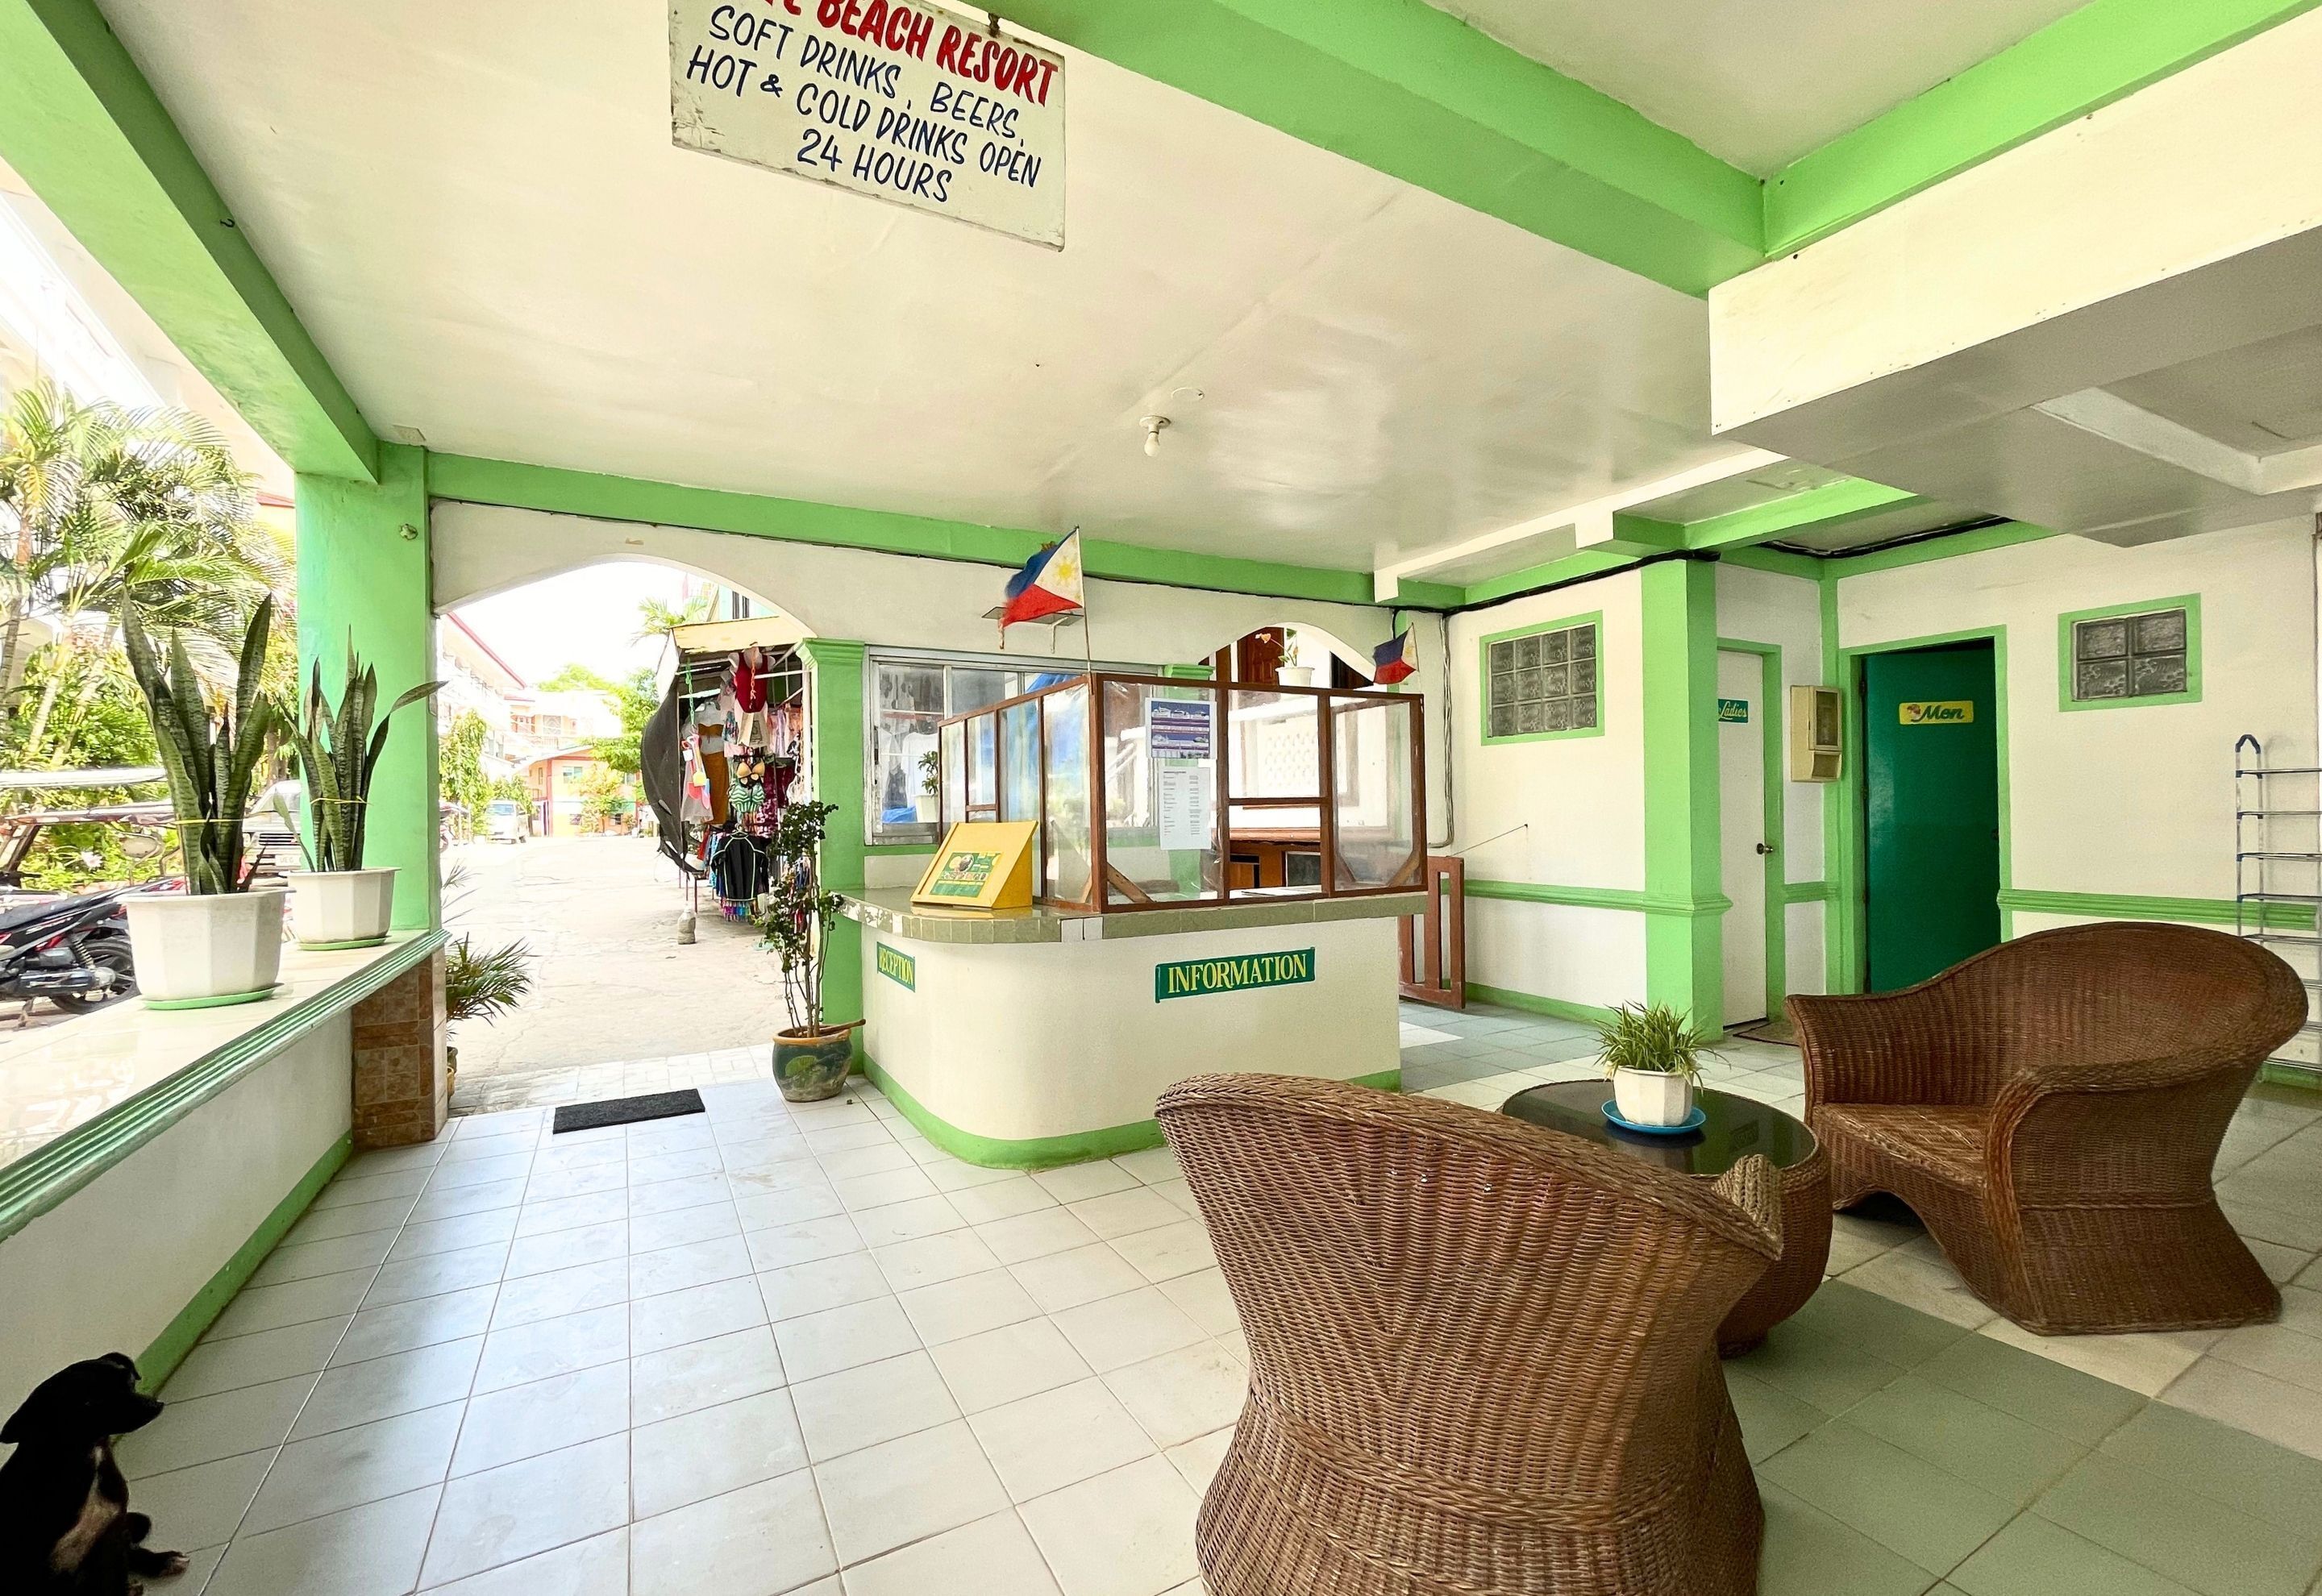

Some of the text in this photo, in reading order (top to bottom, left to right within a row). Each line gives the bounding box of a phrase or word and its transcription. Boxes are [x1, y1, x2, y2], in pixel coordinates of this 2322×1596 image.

[710, 6, 794, 60] SOFT
[817, 0, 1059, 107] BEACH RESORT
[686, 44, 1042, 188] HOT & COLD DRINKS OPEN
[797, 128, 952, 202] 24 HOURS
[1721, 700, 1747, 720] Ladies
[1911, 704, 1965, 722] Men
[879, 946, 913, 985] RECEPTION
[1167, 953, 1307, 994] INFORMATION
